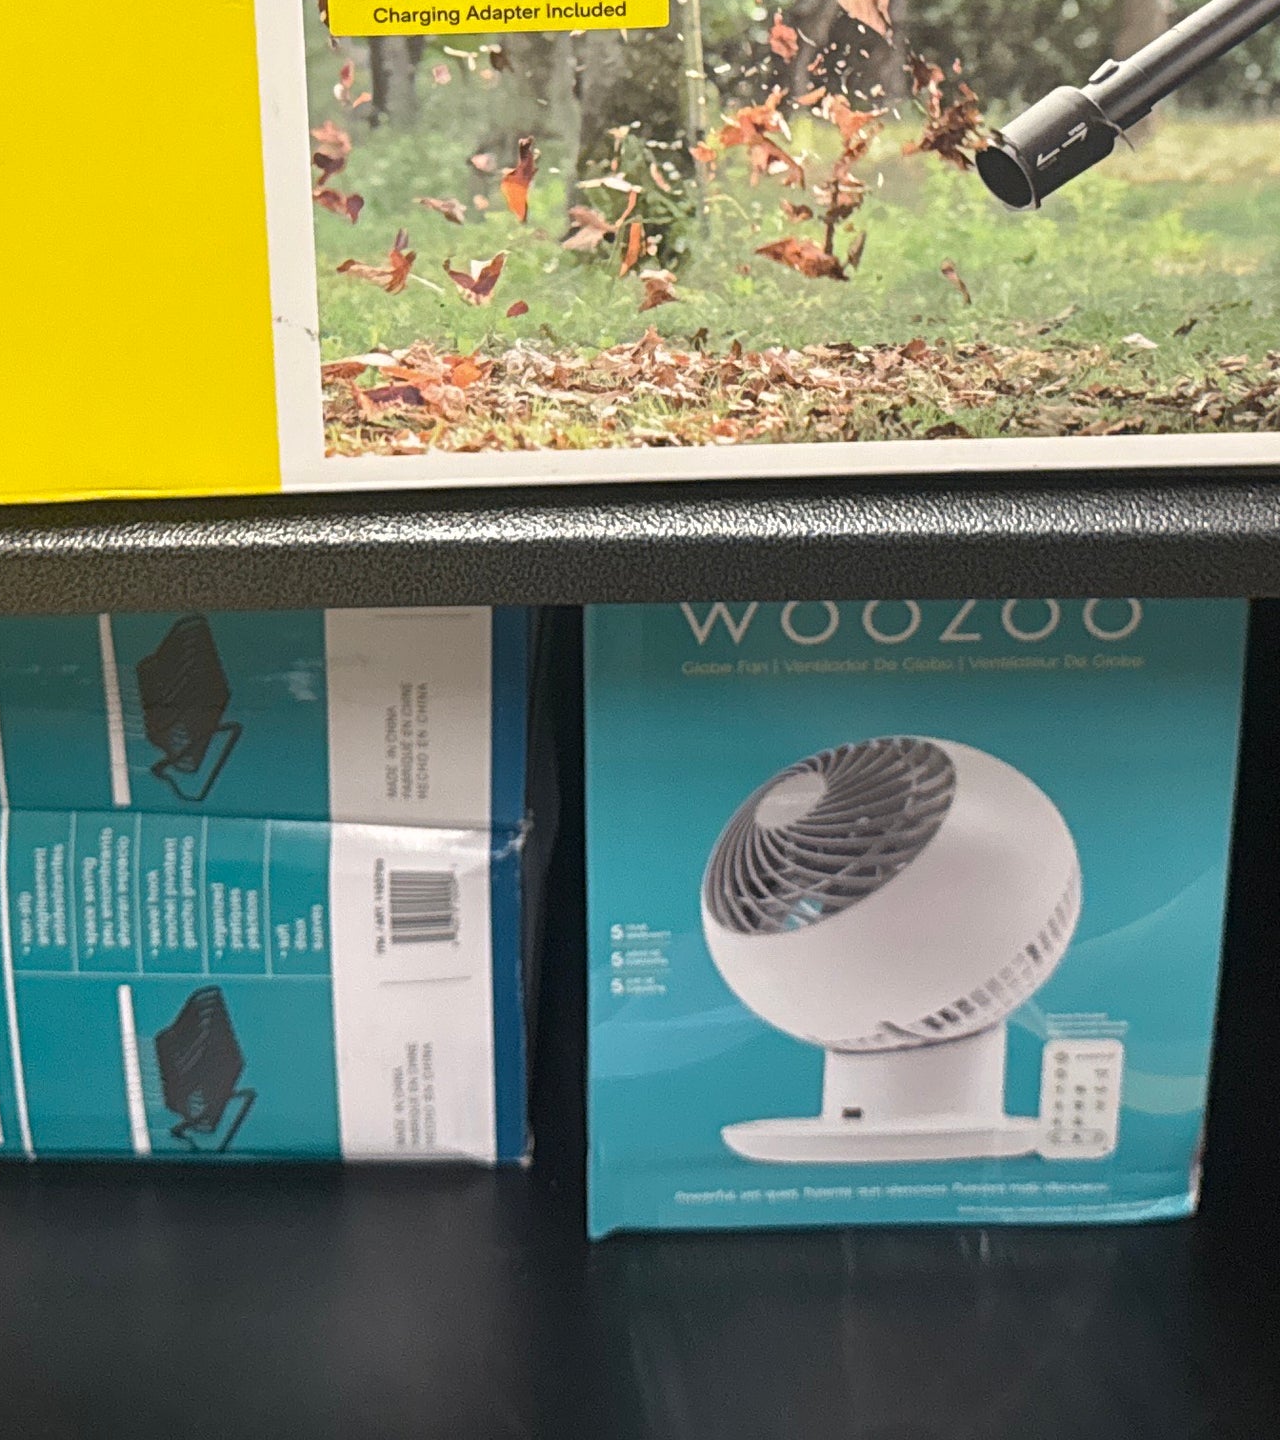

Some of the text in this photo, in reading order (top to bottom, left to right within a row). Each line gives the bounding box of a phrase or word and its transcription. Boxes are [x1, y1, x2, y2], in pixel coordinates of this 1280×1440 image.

[372, 1, 628, 27] Charging Adapter Included
[679, 598, 1144, 645] WOOZOO
